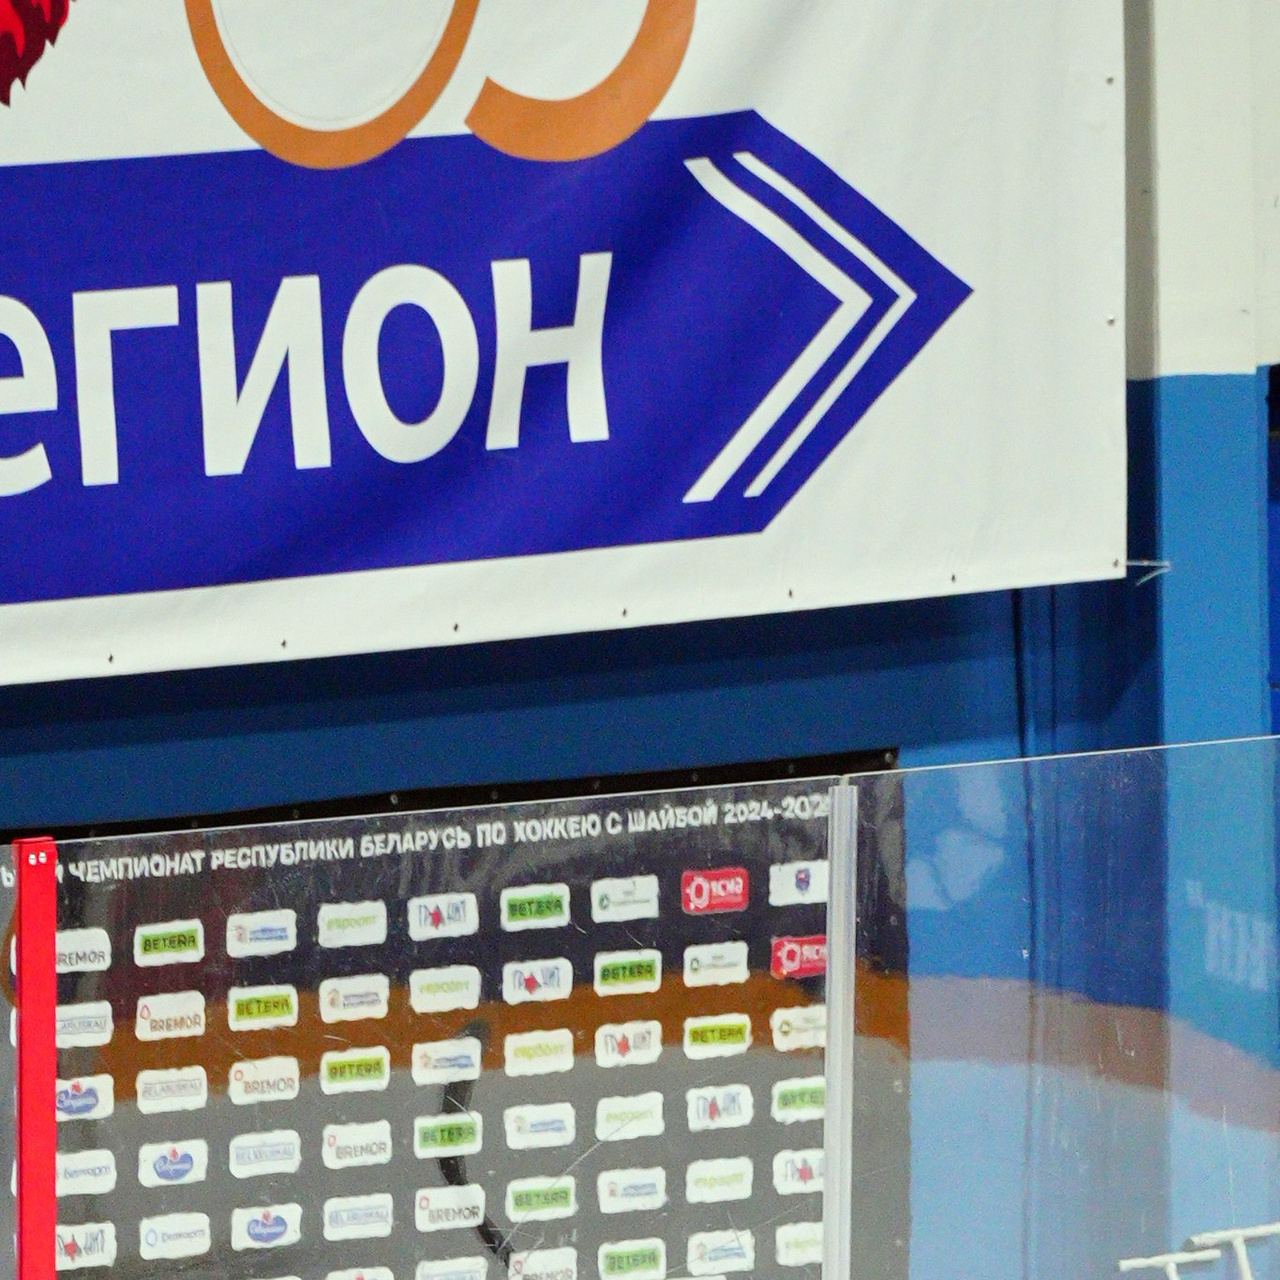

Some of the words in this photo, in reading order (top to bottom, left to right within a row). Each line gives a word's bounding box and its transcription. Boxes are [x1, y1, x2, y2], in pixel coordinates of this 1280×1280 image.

[68, 849, 206, 884] ЧЕМПИОНАТ
[211, 837, 354, 870] РЕСПУБЛИКИ
[361, 825, 472, 858] БЕЛАРУСЬ
[476, 821, 507, 848] ПО
[513, 812, 601, 842] ХОККЕЮ
[605, 811, 623, 835] С
[627, 799, 719, 834] ШАЙБОЙ
[723, 792, 831, 825] 2024-202
[143, 934, 197, 951] BETERA
[57, 951, 106, 966] REMOR
[236, 995, 293, 1016] BETERA
[149, 1014, 202, 1033] BREMOR
[329, 1058, 383, 1079] BETERA
[243, 1077, 296, 1094] BREMOR
[335, 1141, 388, 1160] BREMOR
[428, 1205, 481, 1224] BREMOR
